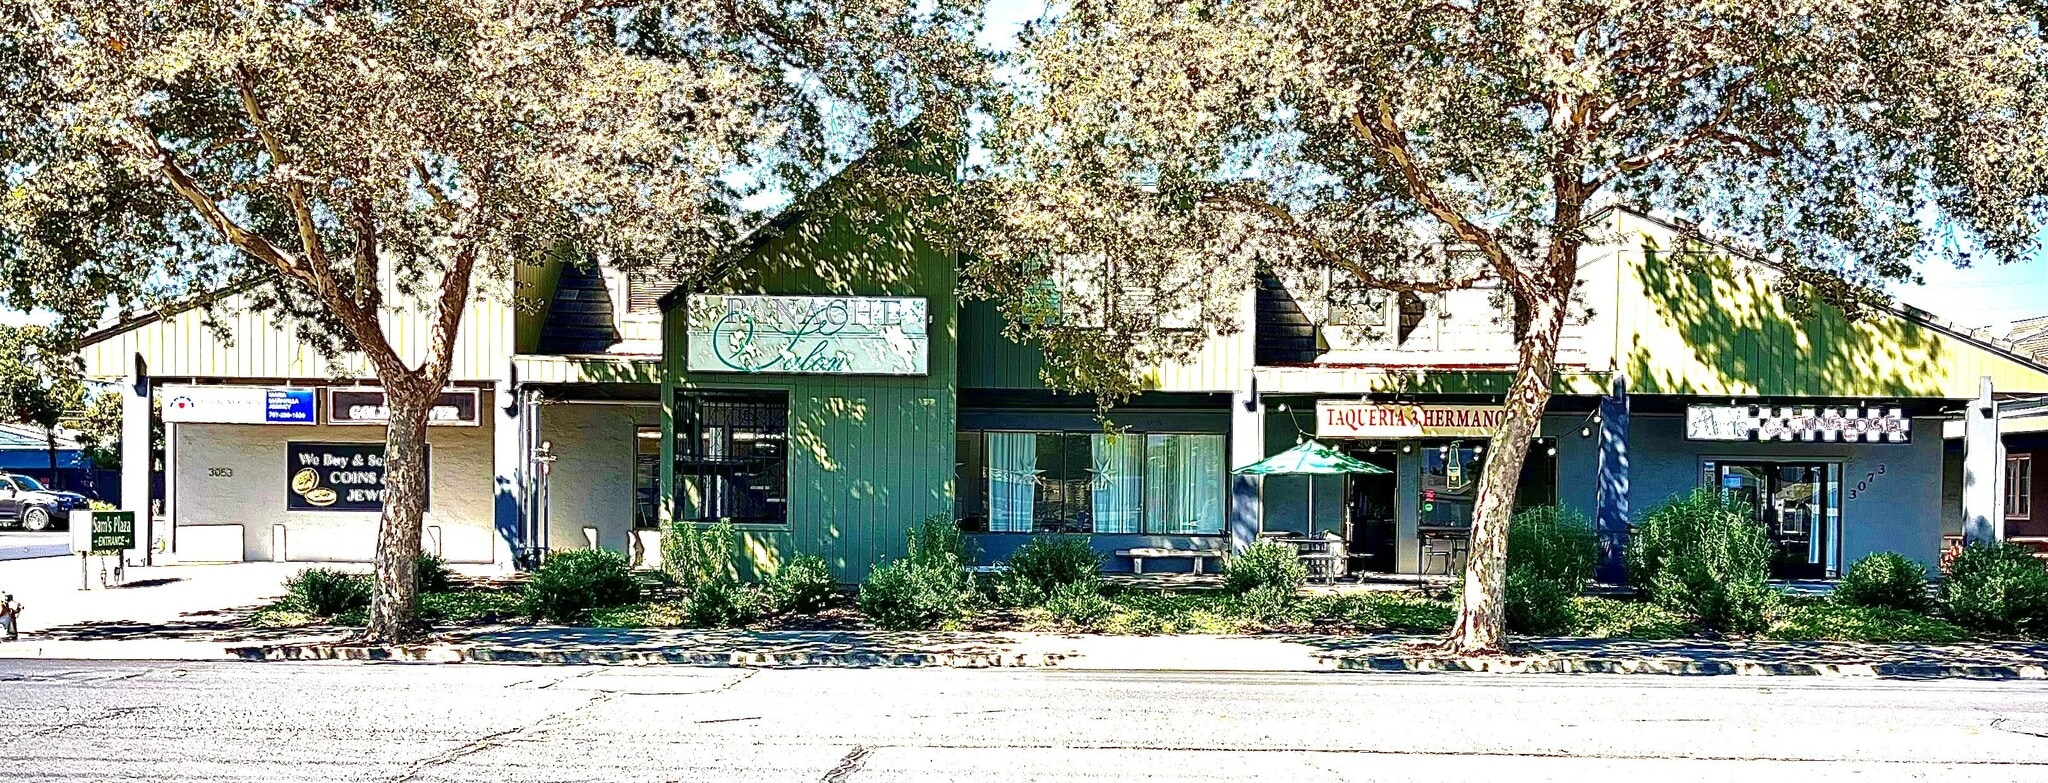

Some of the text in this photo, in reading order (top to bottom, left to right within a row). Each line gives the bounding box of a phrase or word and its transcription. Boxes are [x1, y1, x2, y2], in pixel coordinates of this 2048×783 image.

[725, 297, 901, 326] PANACHE
[349, 405, 391, 420] GOLD
[1326, 408, 1505, 431] TAQUERIA 3 HERMANO
[299, 453, 385, 468] We Buy & Se
[208, 467, 233, 478] 3053
[329, 471, 377, 484] COINS
[1848, 463, 1886, 500] 3073
[93, 515, 131, 533] Sam's Plaza
[98, 536, 125, 547] ENTRANCE
